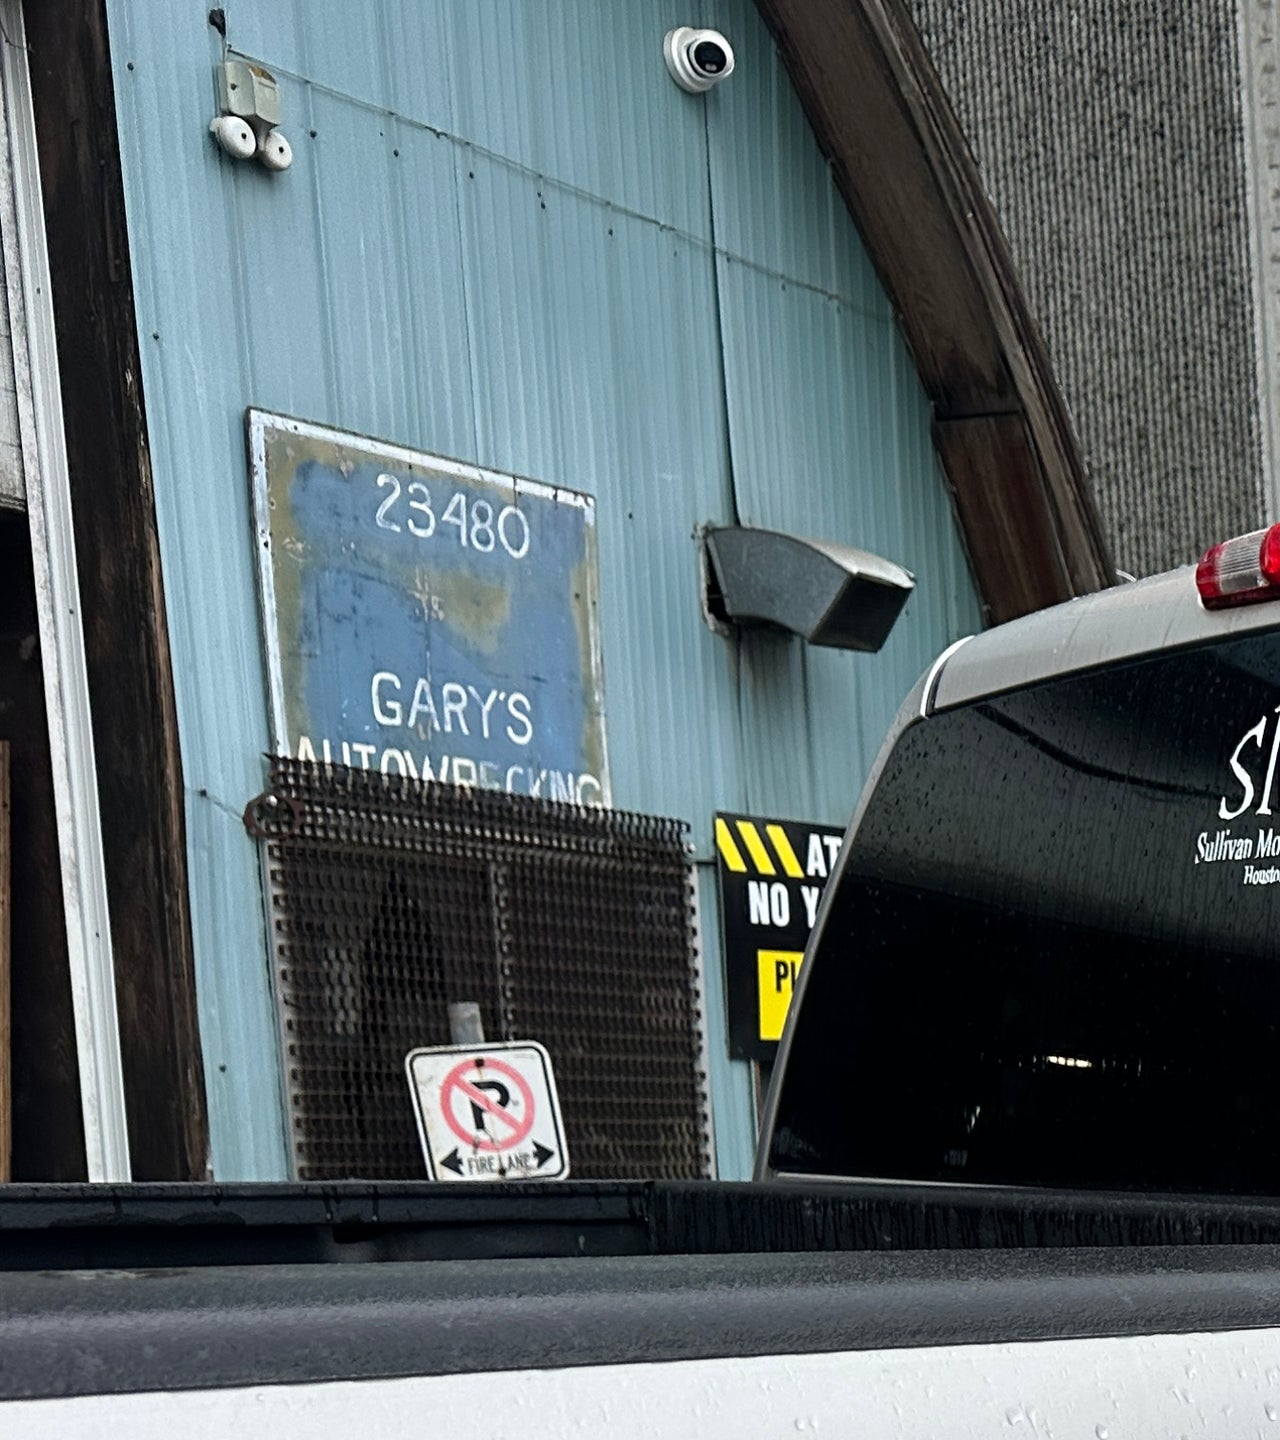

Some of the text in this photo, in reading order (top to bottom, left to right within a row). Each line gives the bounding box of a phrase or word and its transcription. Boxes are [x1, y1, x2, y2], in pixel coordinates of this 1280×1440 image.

[375, 473, 532, 560] 23480
[1195, 829, 1253, 864] Sullivan
[748, 880, 790, 927] NO
[467, 1155, 494, 1176] FIRE
